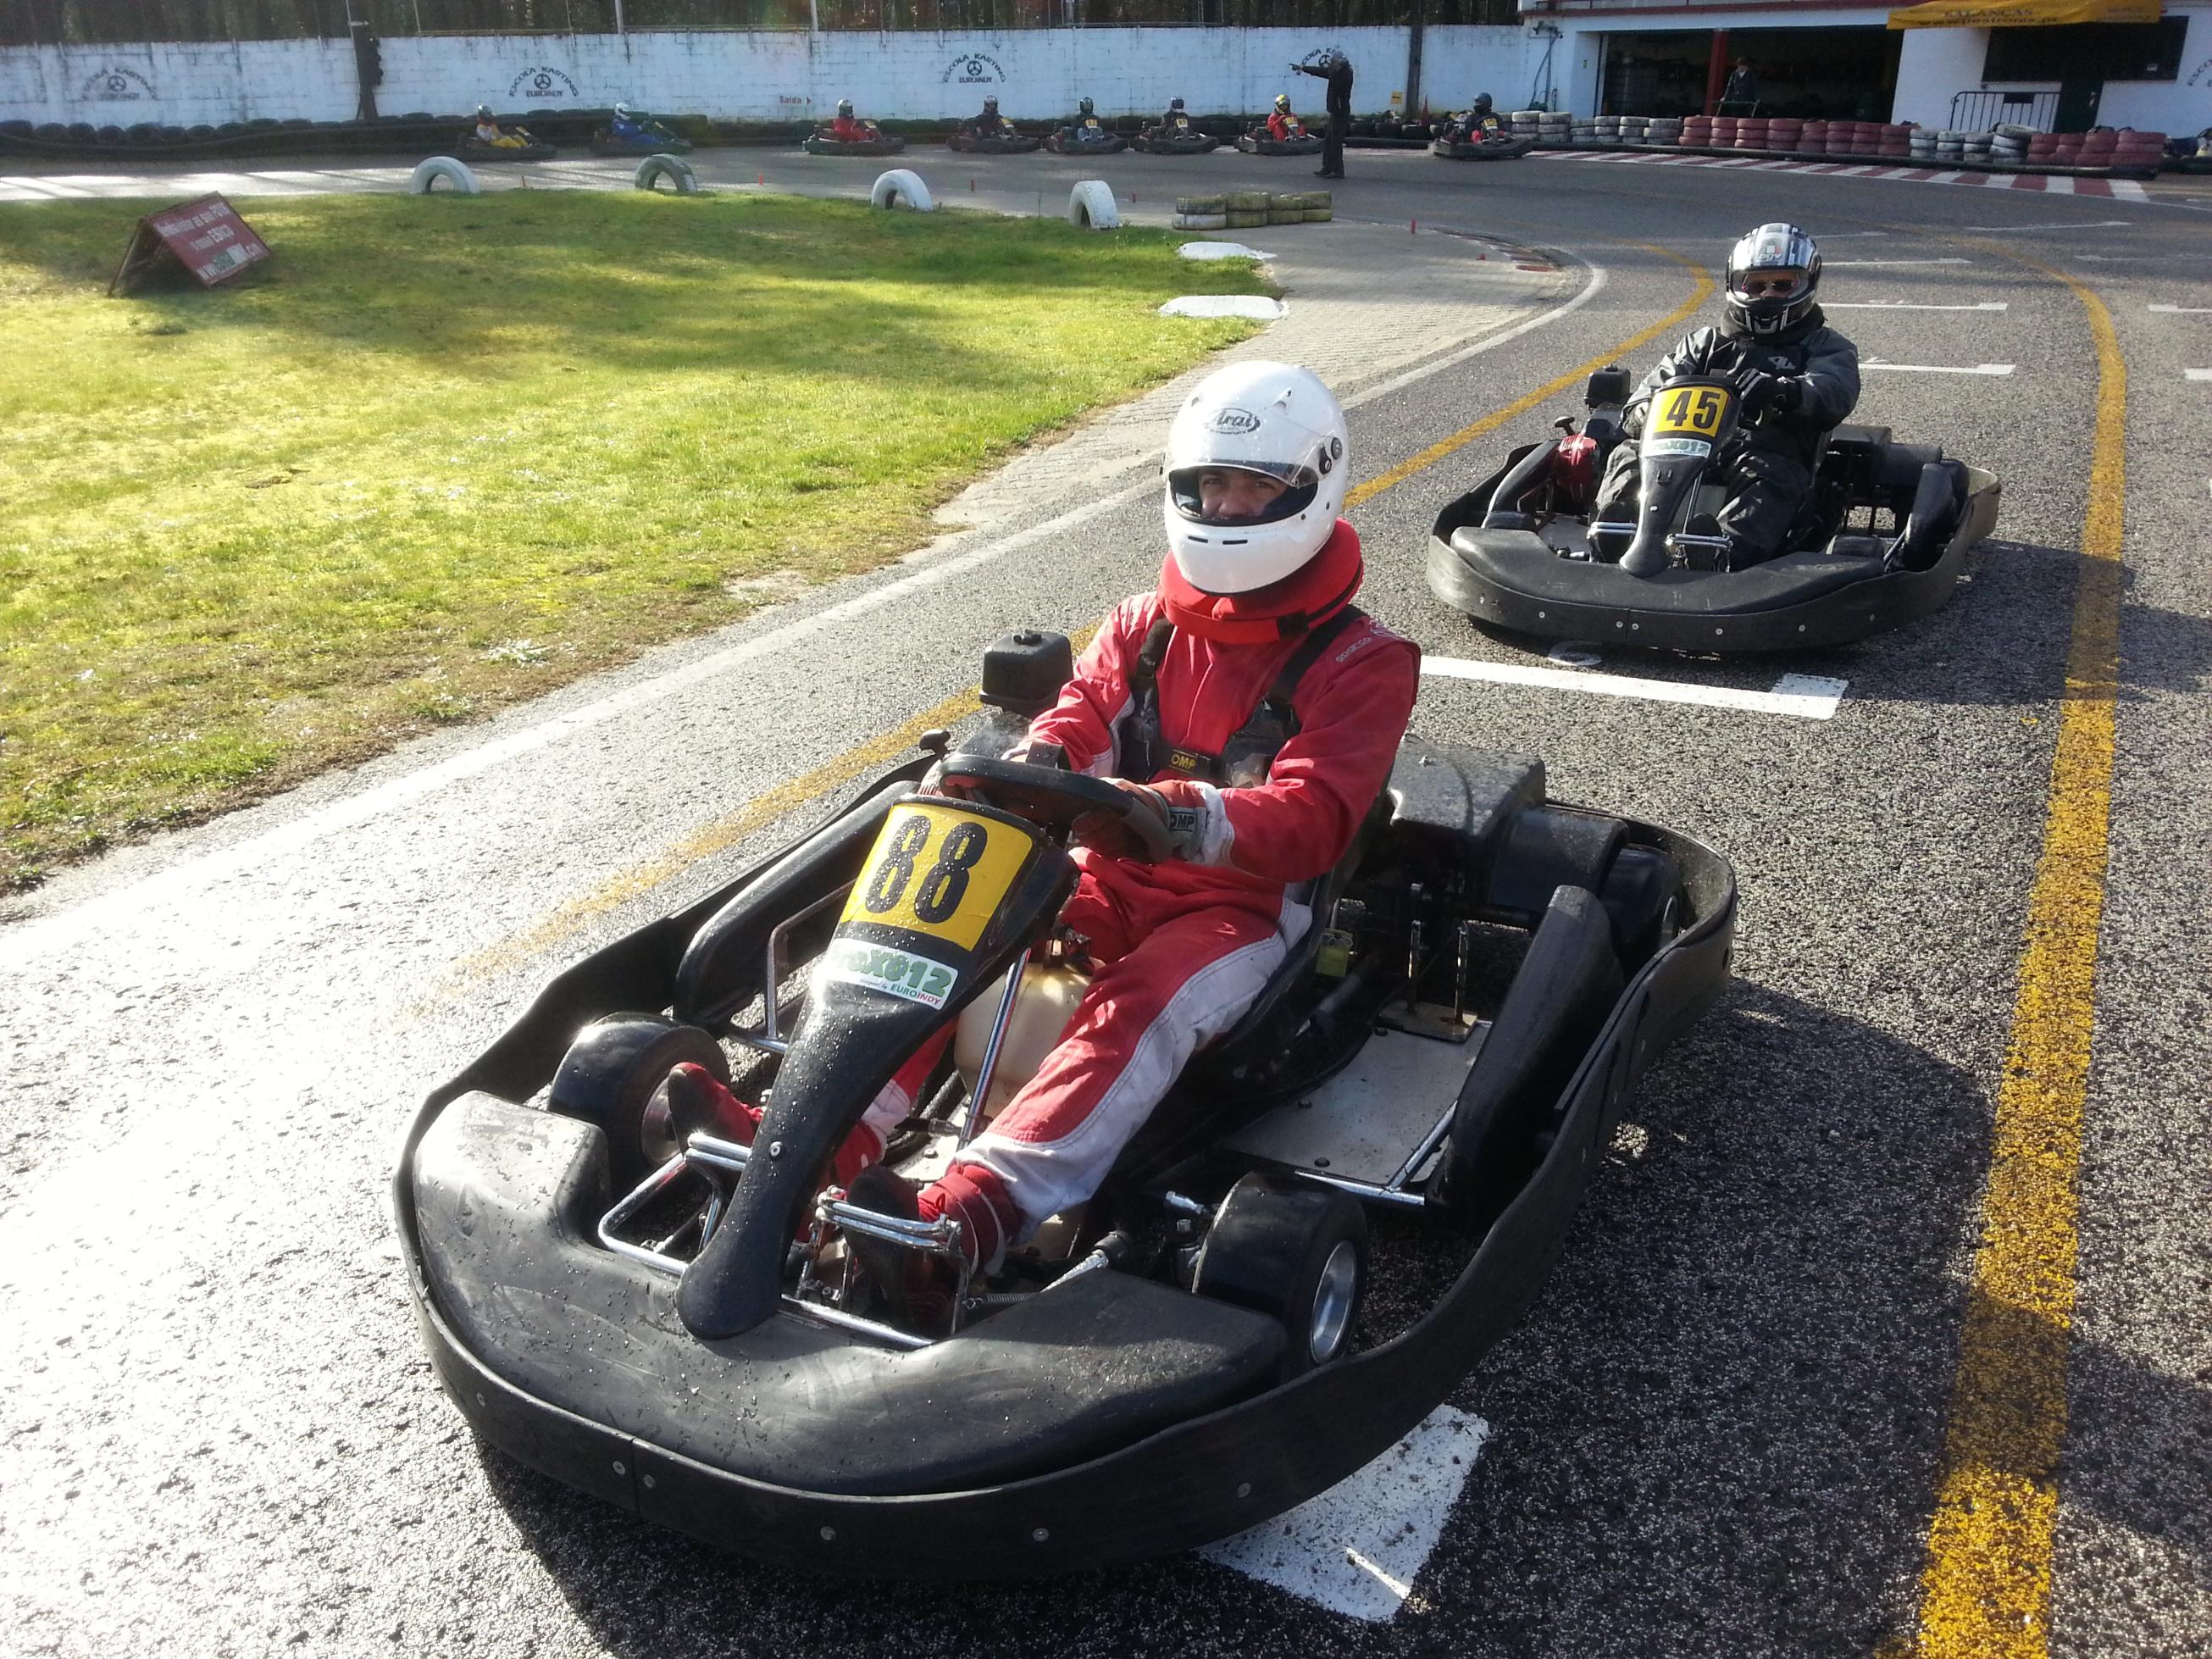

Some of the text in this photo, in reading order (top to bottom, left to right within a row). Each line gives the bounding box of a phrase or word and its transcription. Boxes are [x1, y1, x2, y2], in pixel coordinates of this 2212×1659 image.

[509, 66, 579, 97] ESCOLA KARTING
[974, 53, 1006, 83] KARTING
[1666, 390, 1721, 430] 45
[1171, 753, 1196, 770] OMP
[865, 814, 988, 924] 88
[890, 983, 941, 1005] EUROINDY
